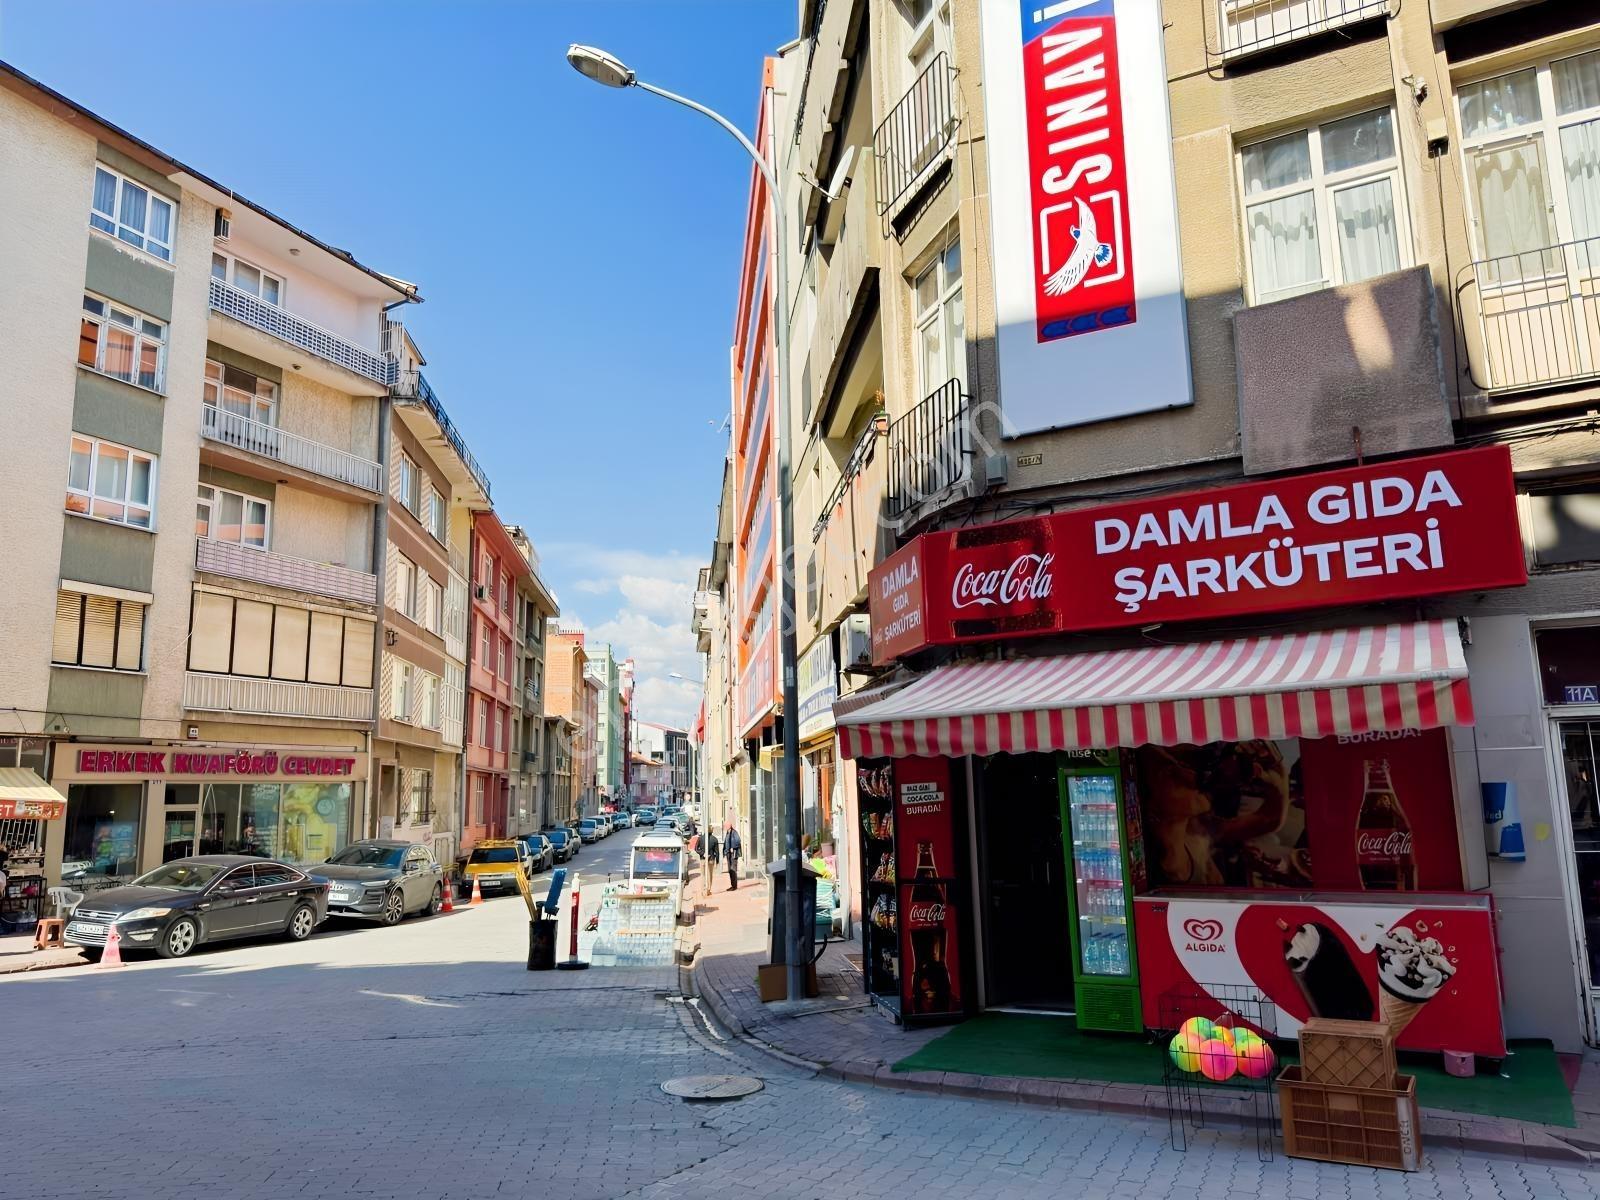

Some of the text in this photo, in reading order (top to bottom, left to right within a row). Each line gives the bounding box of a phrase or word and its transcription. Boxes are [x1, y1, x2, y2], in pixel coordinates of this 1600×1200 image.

[1042, 27, 1112, 194] SINAV
[1095, 471, 1463, 555] DAMLA GIDA
[1114, 518, 1443, 612] ŞARKÜTERİ
[881, 556, 919, 600] DAMLA
[952, 553, 1055, 609] Coca-Cola
[892, 591, 909, 614] GIDA
[884, 604, 921, 645] ŞARKÜTERİ
[1567, 687, 1595, 701] 11A
[79, 749, 356, 776] ERKEK KUAFÖRÜ CEVDET
[906, 794, 940, 803] COCA-COLA
[906, 804, 941, 815] BURADA!
[1357, 831, 1412, 855] Coca-Cola
[910, 903, 946, 922] Coca-Cola
[1185, 943, 1225, 953] ALGIDA
